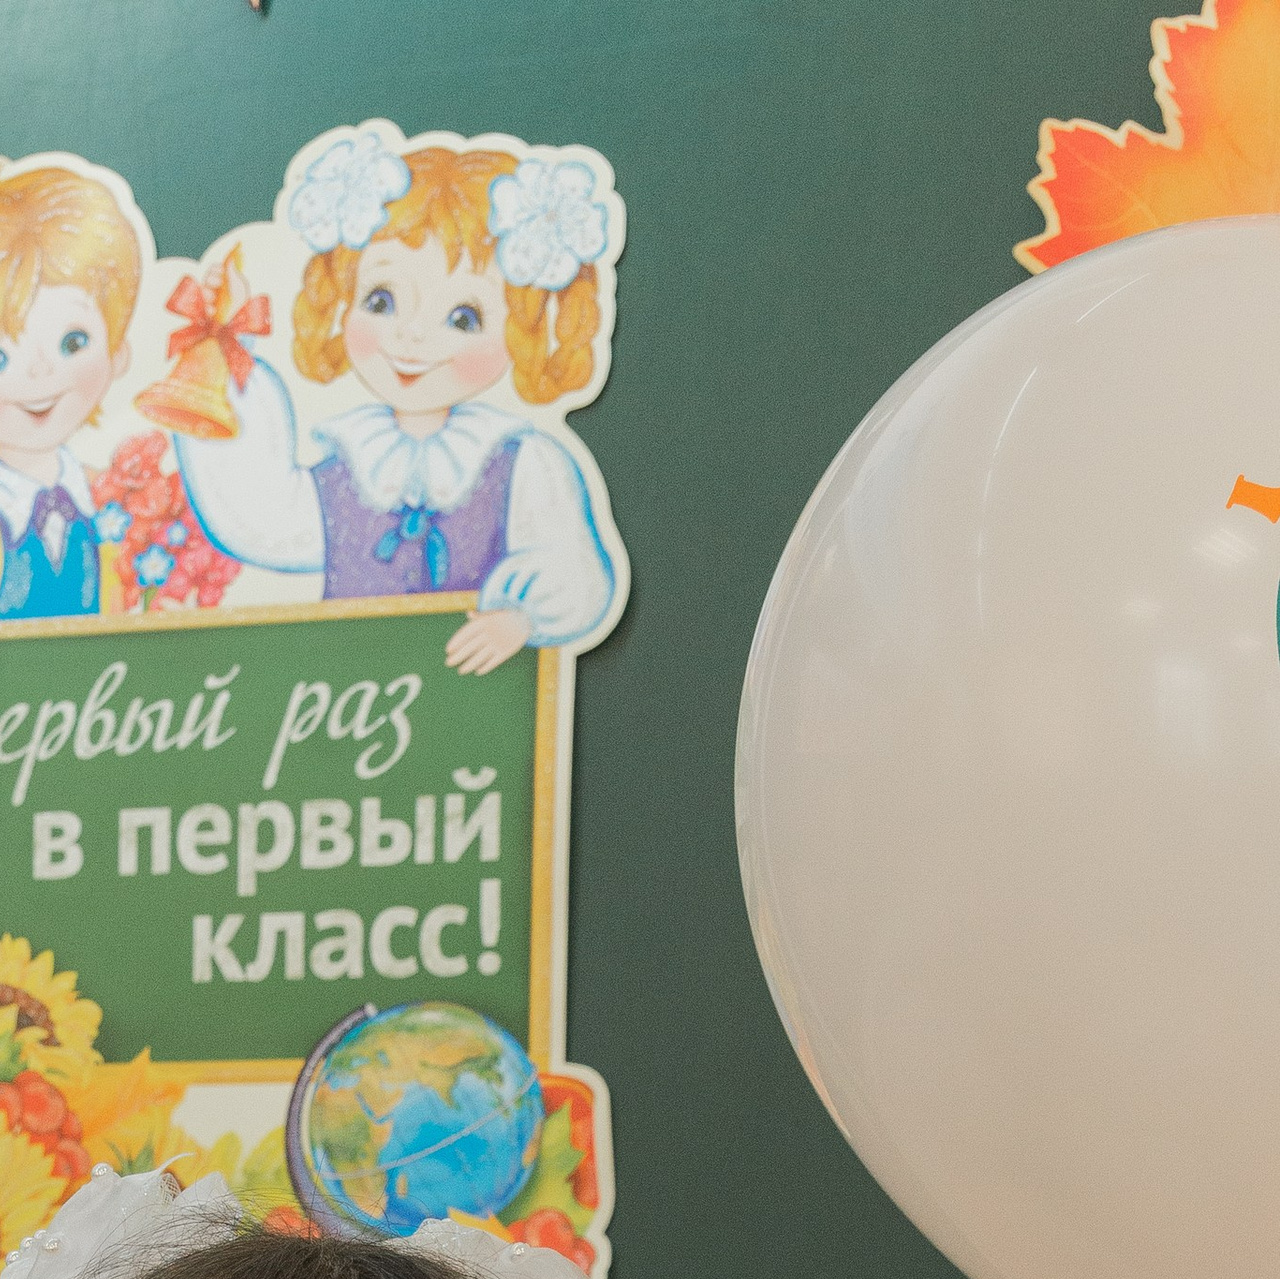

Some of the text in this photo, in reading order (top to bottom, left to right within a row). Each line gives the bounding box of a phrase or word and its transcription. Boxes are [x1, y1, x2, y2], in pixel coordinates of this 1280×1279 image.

[261, 672, 422, 789] раз
[32, 766, 503, 898] в первый
[190, 877, 503, 984] класс!
